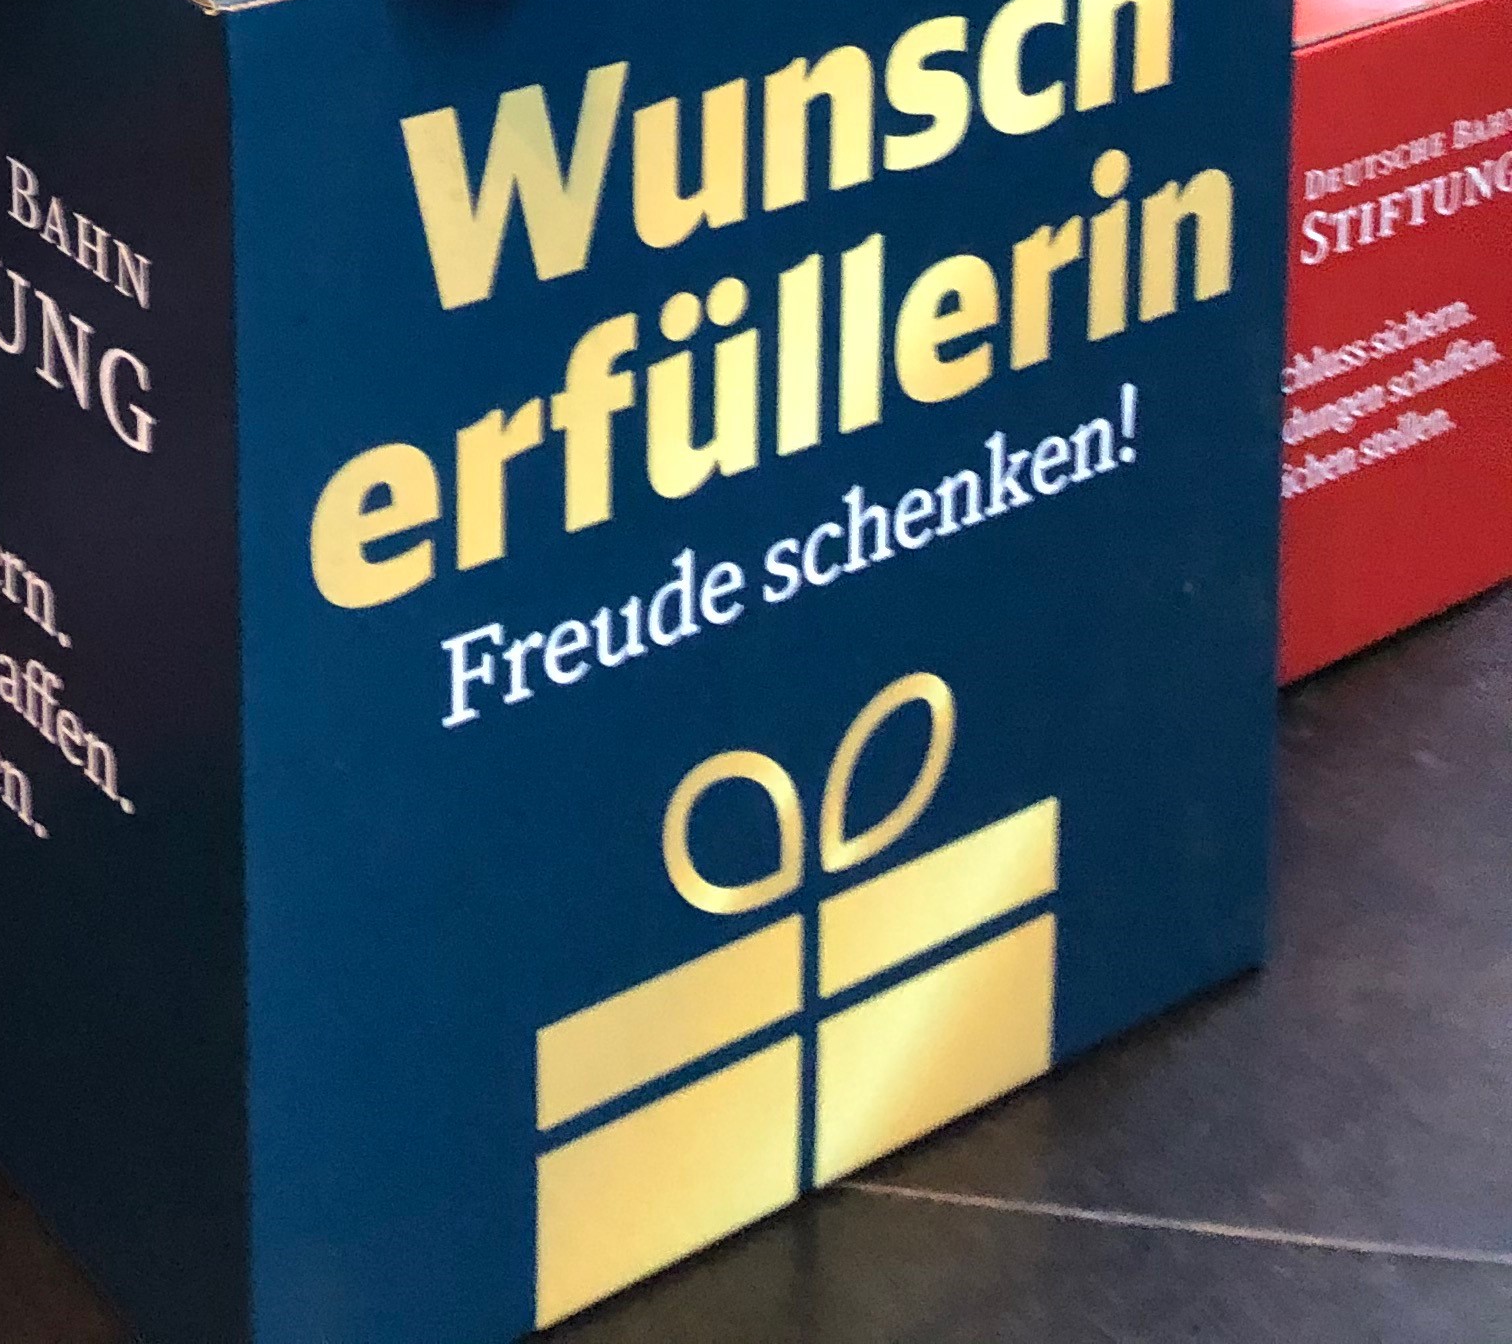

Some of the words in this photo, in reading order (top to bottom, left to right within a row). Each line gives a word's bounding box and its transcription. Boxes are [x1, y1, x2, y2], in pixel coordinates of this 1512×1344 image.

[6, 155, 152, 309] BAHN
[1299, 151, 1512, 266] STIFTUNG
[1303, 131, 1448, 201] DEUTSCHE
[309, 149, 1234, 610] erfüllerin
[440, 550, 746, 728] Freude
[763, 383, 1139, 605] schenken!
